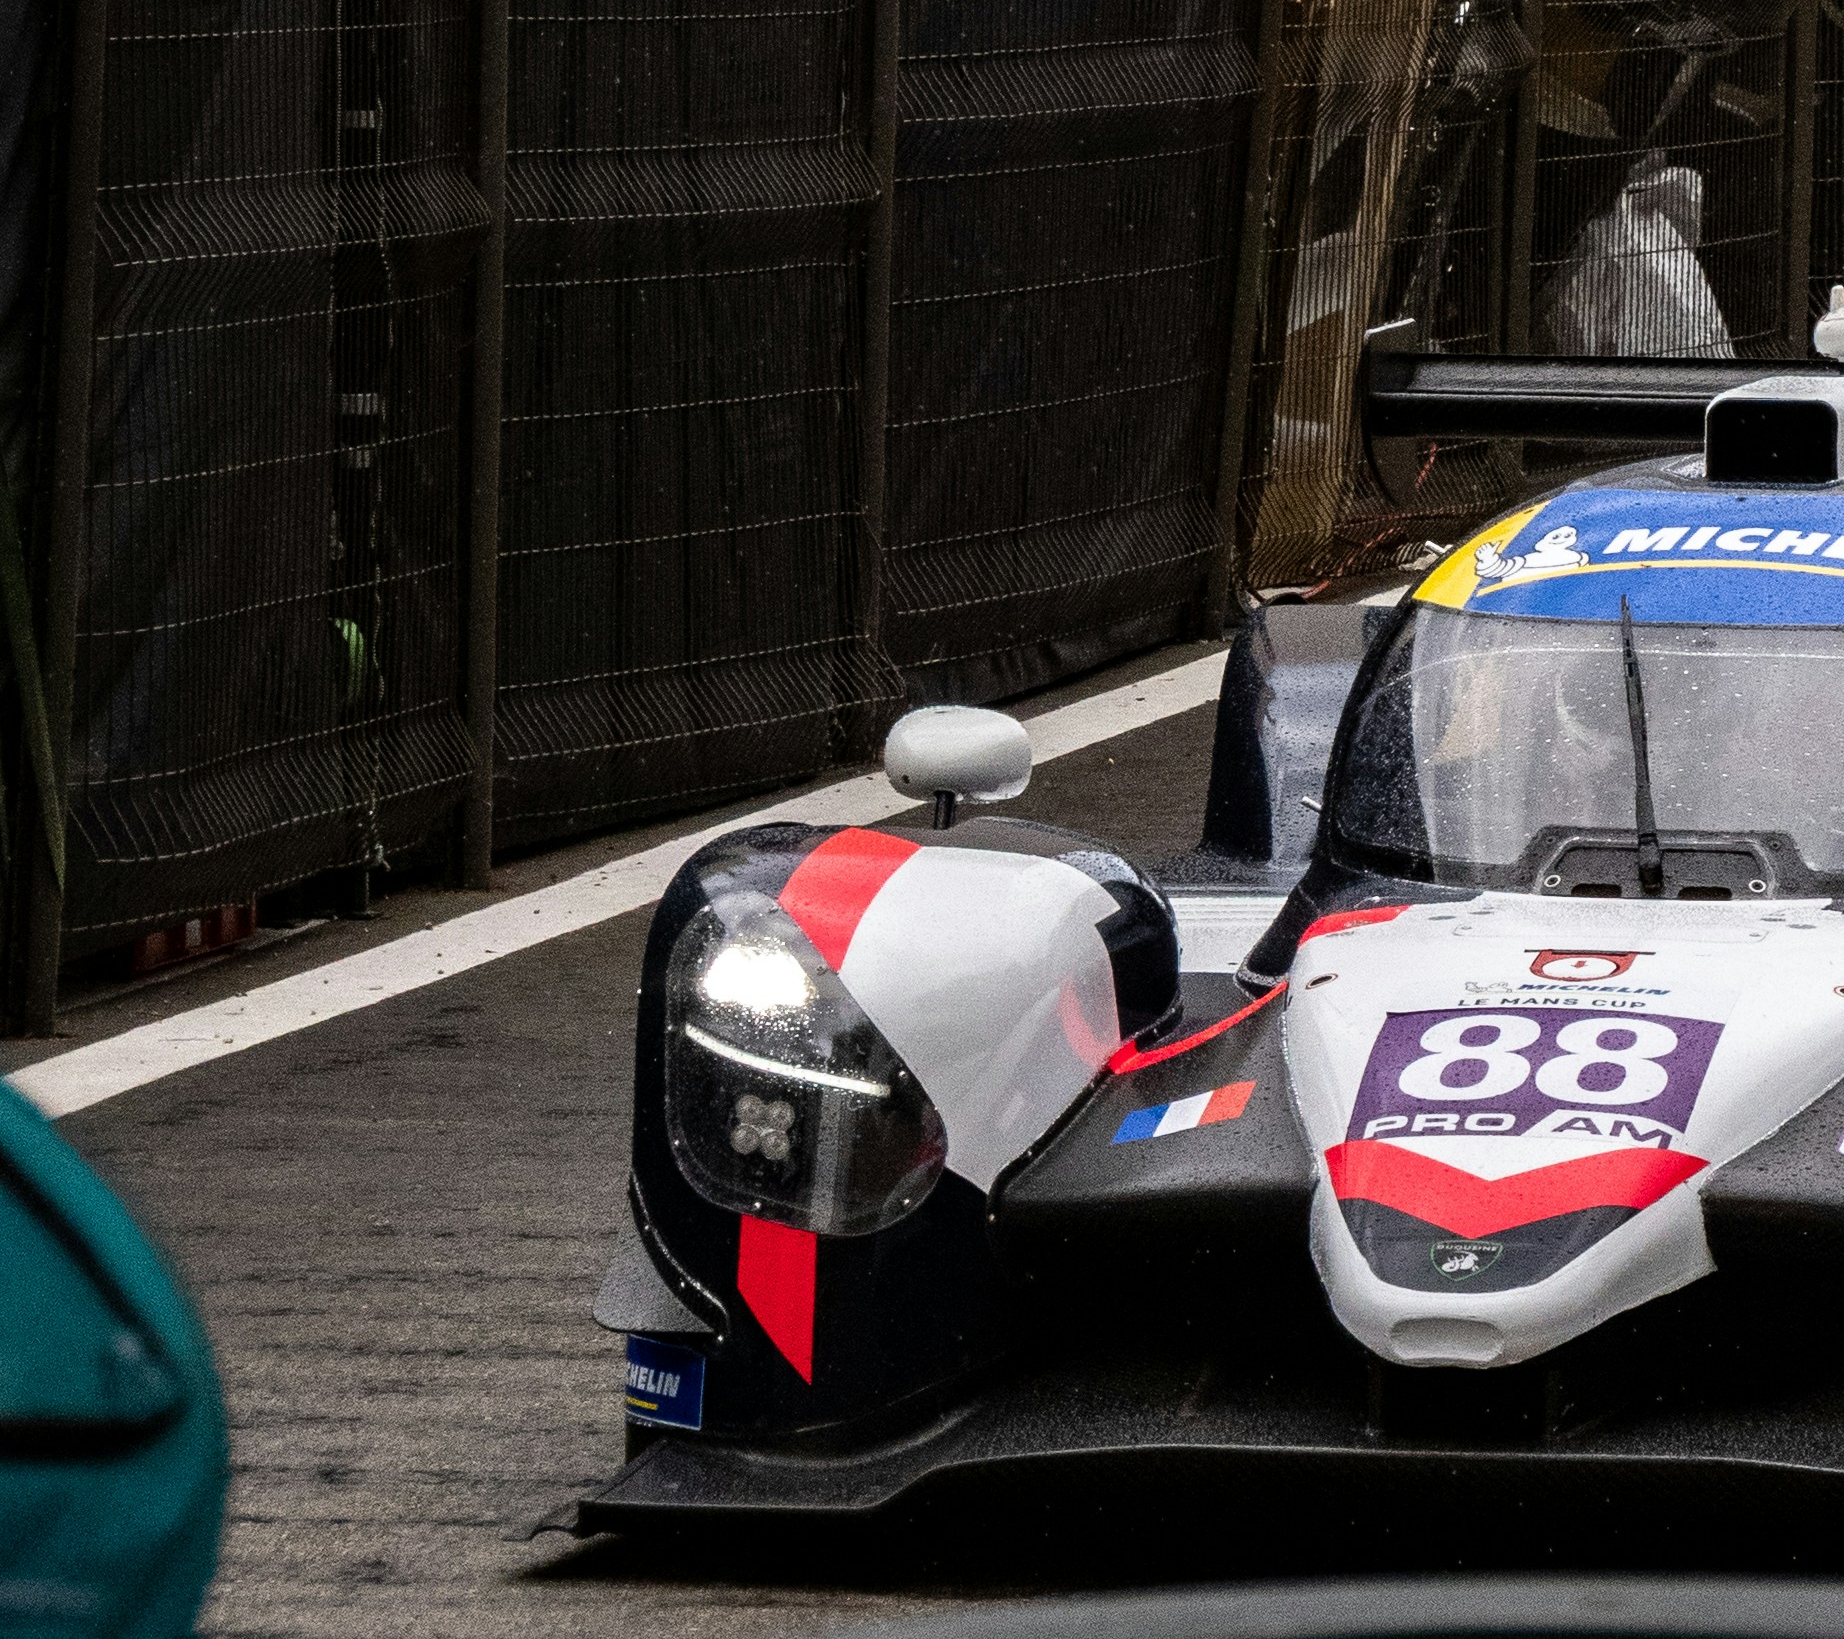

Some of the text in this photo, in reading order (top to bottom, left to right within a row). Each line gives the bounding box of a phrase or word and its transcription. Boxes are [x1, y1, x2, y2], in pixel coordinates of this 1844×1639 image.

[1457, 997, 1647, 1009] LE MANS CUP
[1518, 983, 1672, 996] MICHELIN
[1398, 1014, 1679, 1106] 88
[1363, 1112, 1673, 1150] PRO AM
[626, 1363, 681, 1398] HELIN
